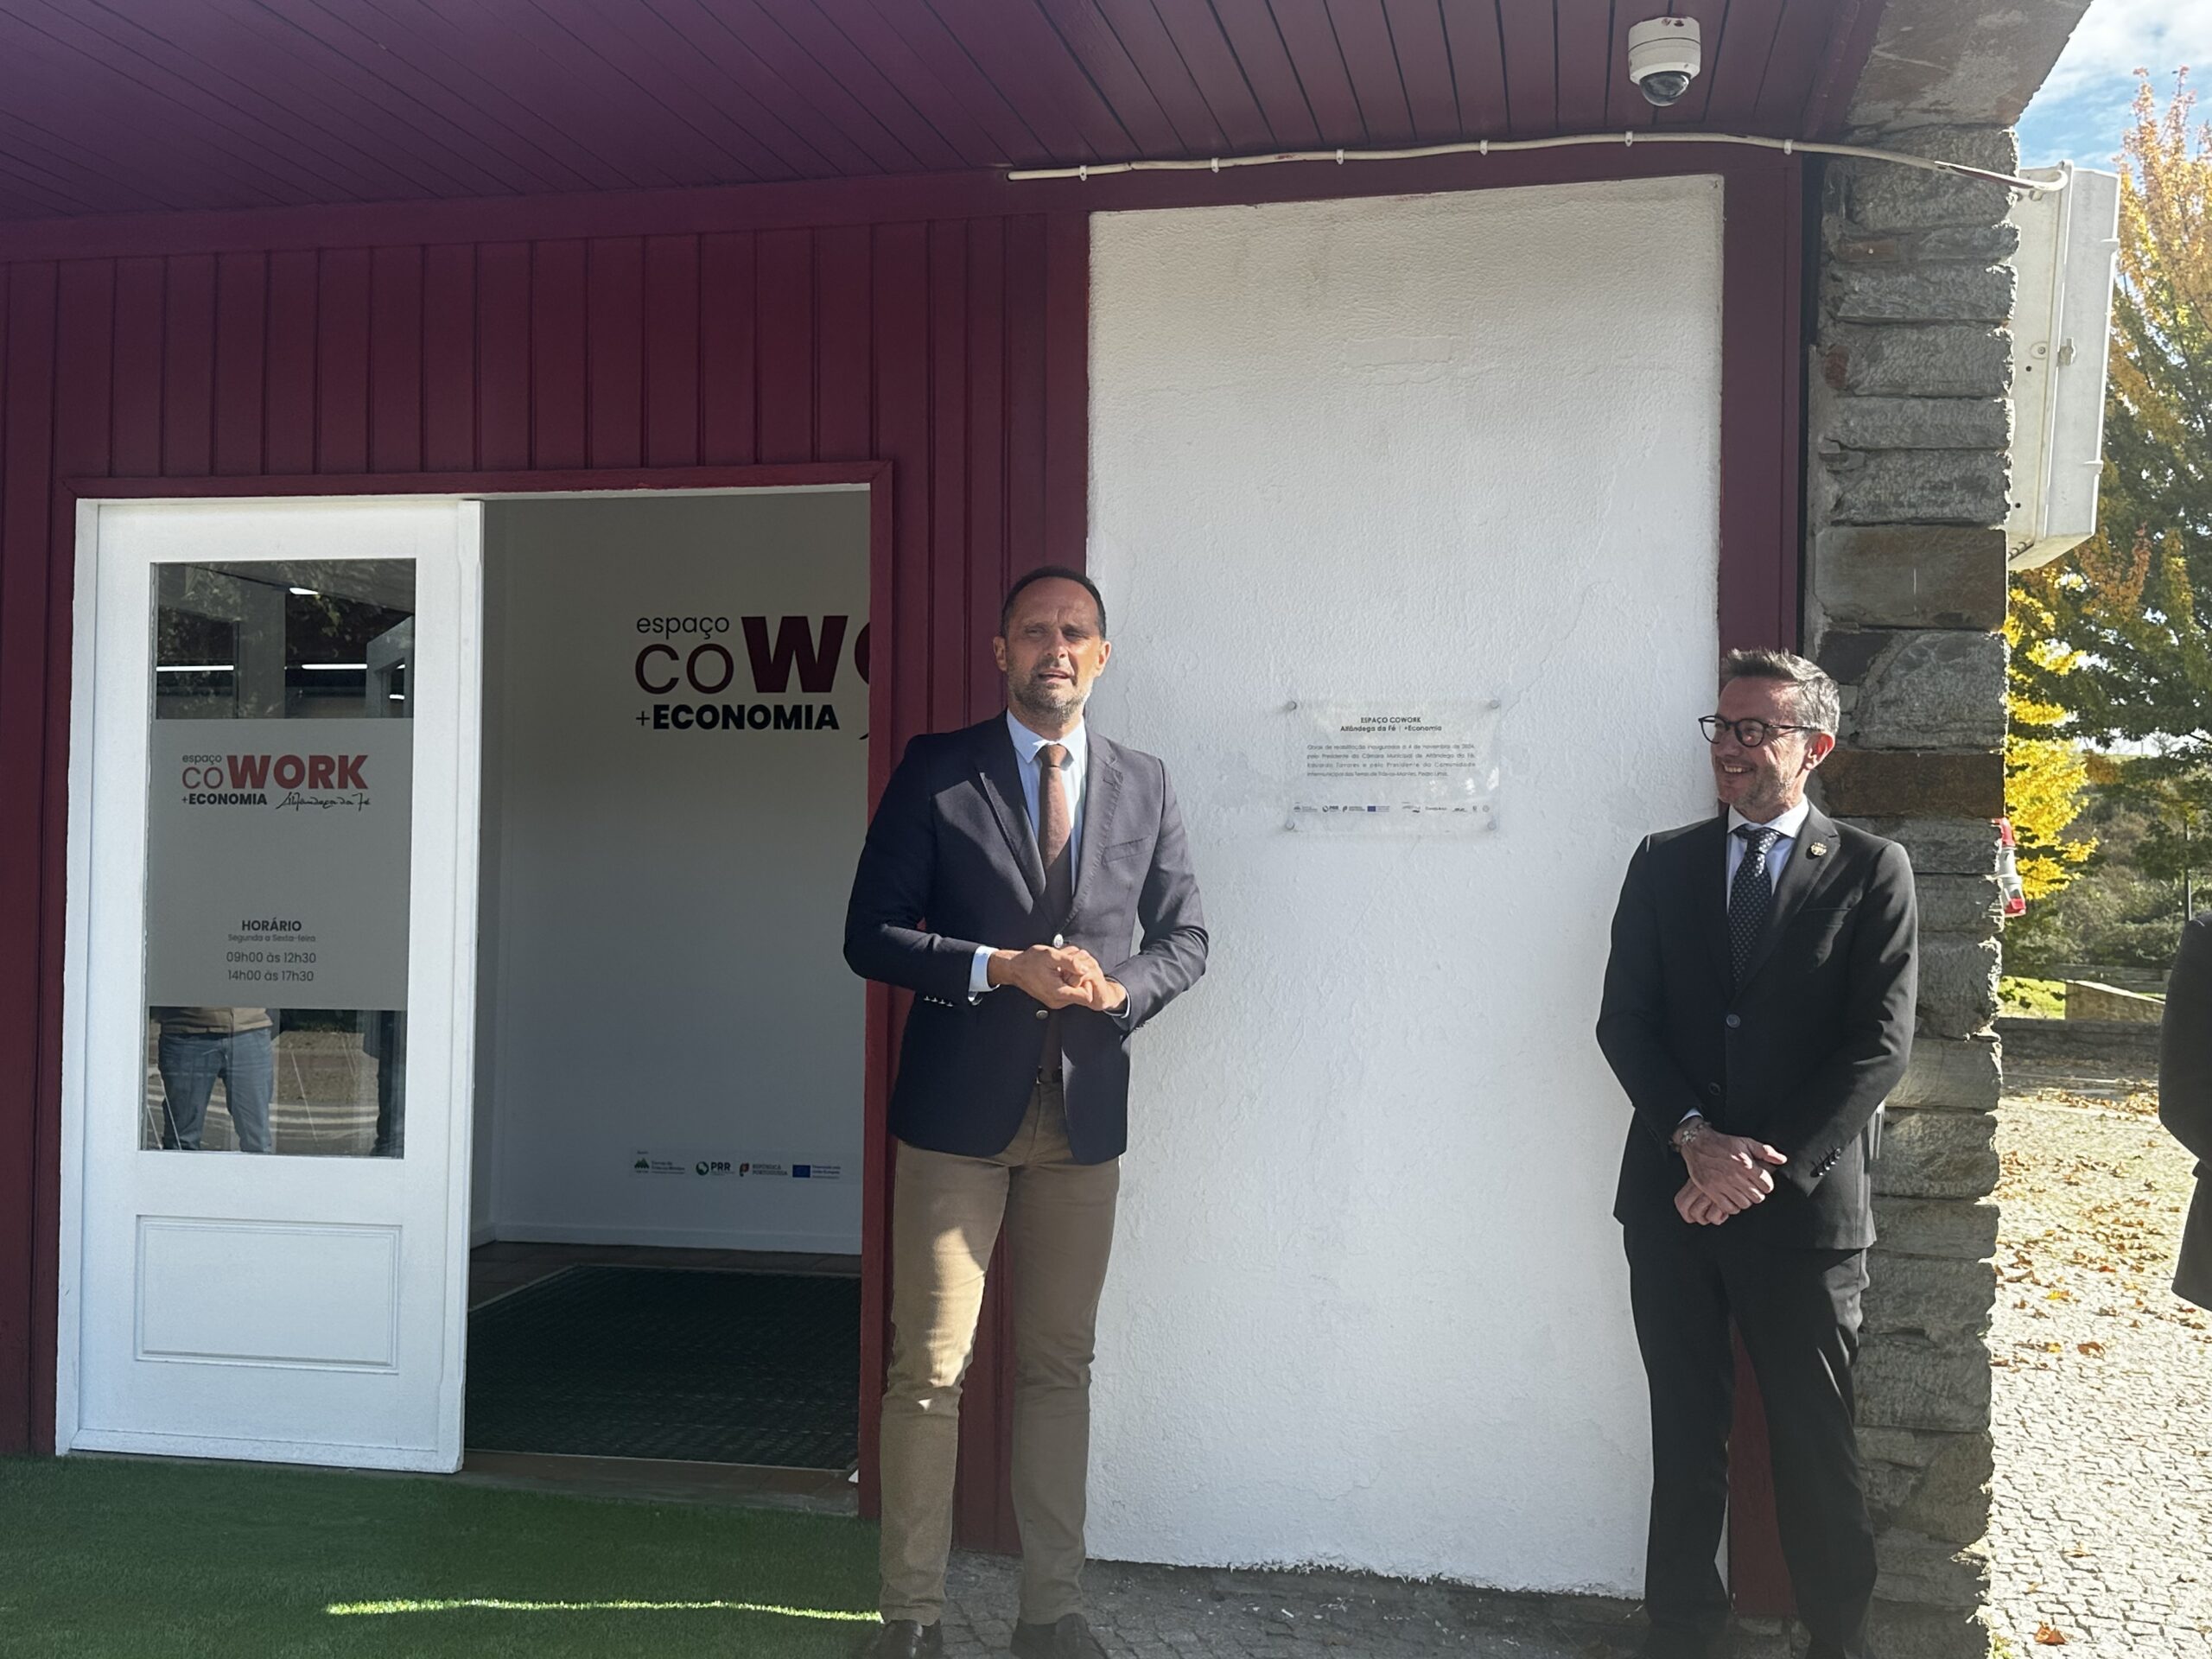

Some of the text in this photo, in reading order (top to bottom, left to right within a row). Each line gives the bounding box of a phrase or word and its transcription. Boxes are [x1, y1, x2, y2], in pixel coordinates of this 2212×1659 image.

[636, 616, 730, 639] espaço
[635, 704, 840, 730] +ECONOMIA
[181, 753, 223, 766] espaço
[181, 792, 268, 806] +ECONOMIA
[241, 917, 302, 932] HORÁRIO
[227, 933, 264, 944] Segunda
[226, 951, 317, 964] 09h00 às 12h30
[227, 969, 262, 982] 14h00
[281, 970, 315, 982] 17h30
